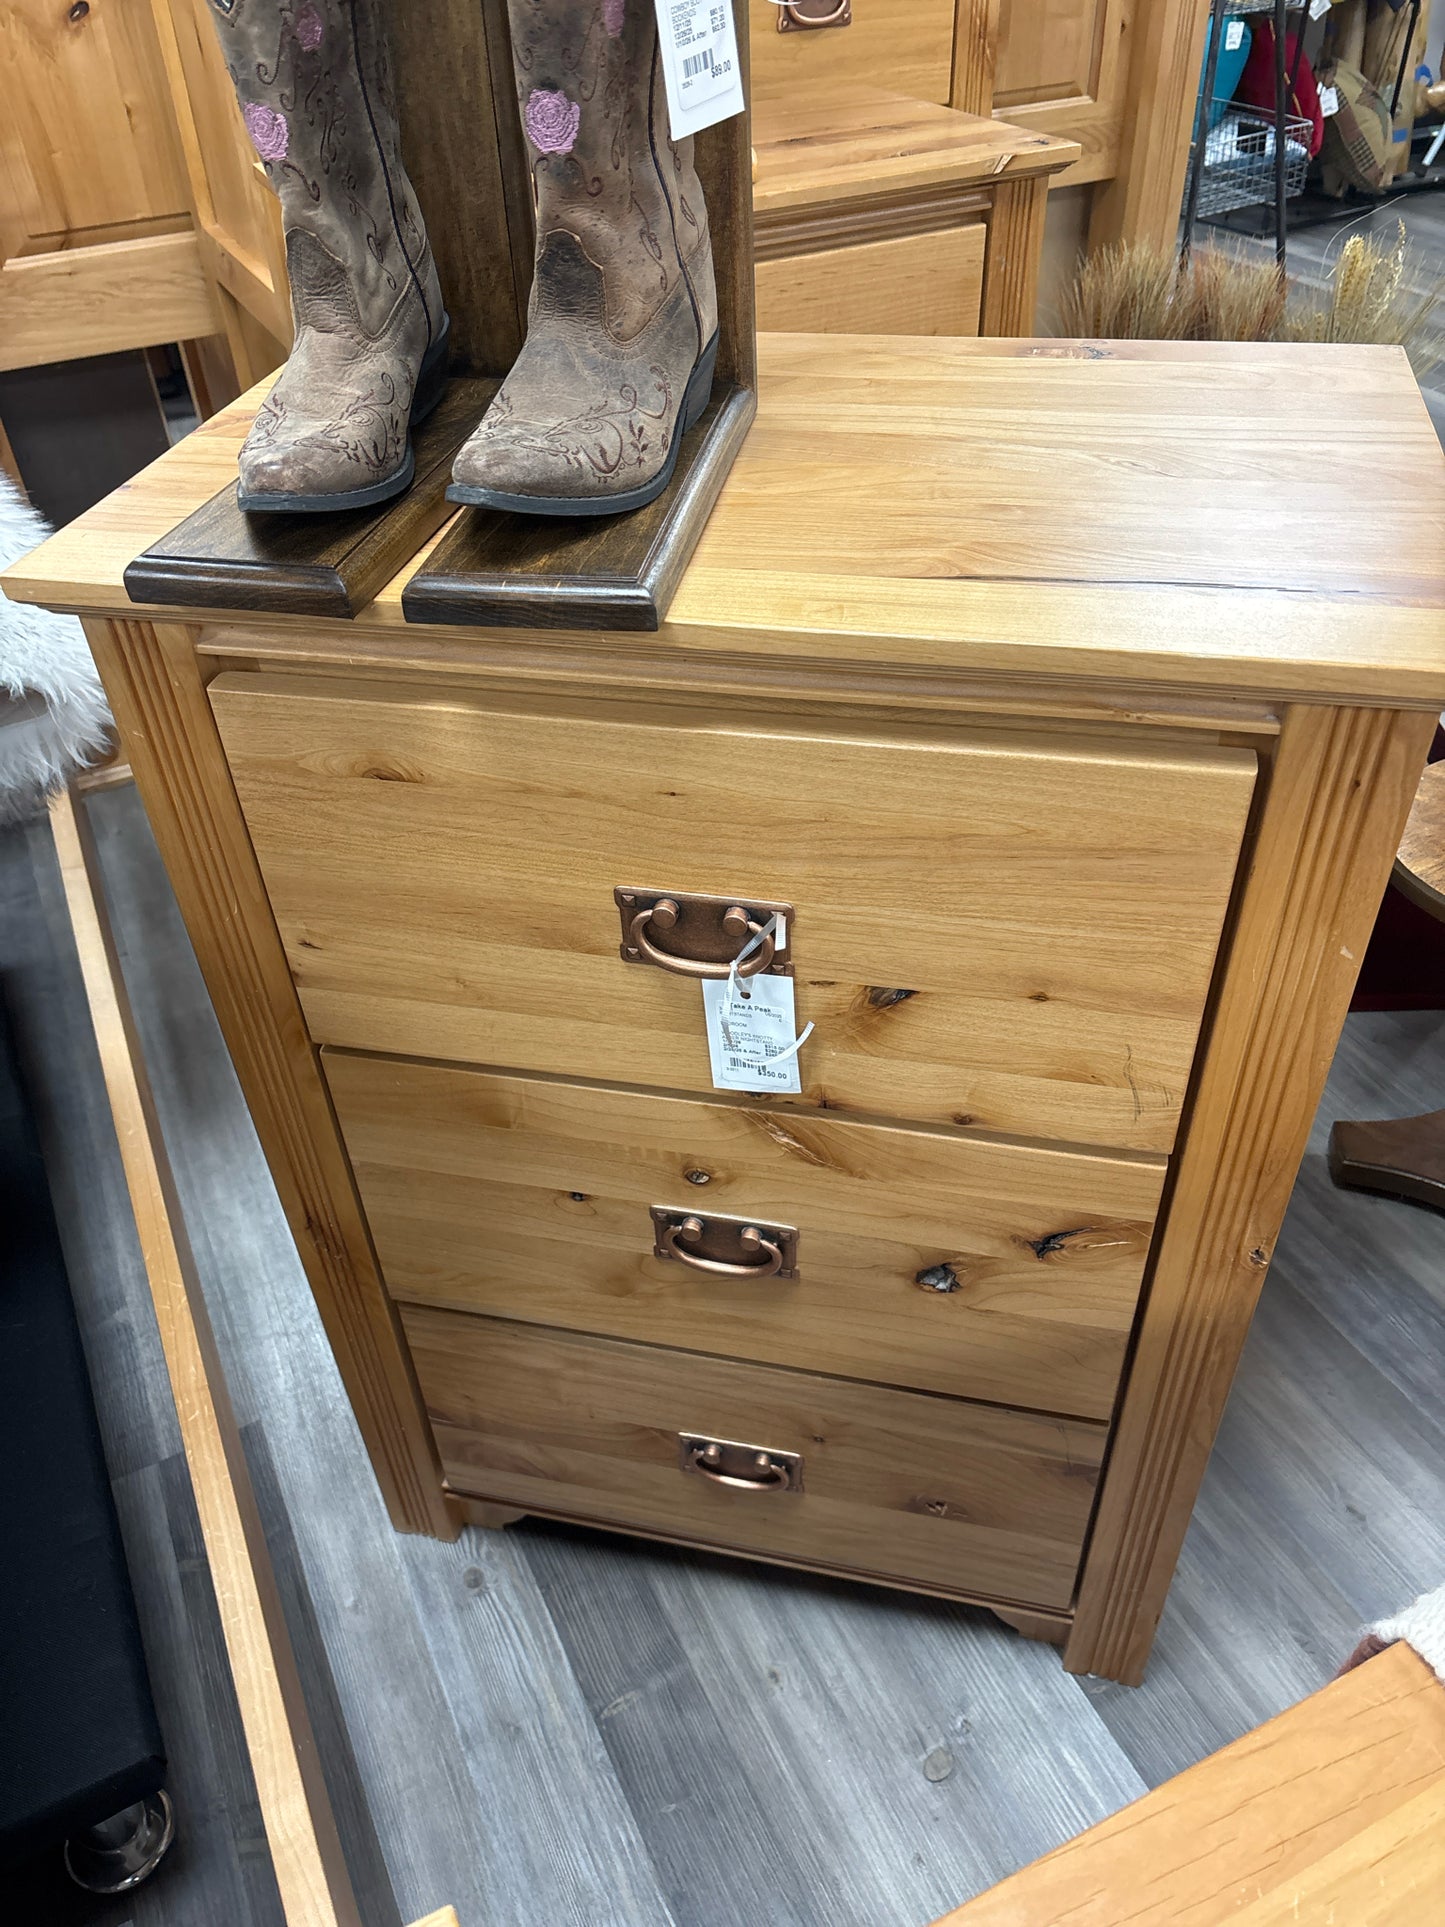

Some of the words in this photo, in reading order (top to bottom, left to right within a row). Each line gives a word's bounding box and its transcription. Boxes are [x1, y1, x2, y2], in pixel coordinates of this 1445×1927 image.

[711, 59, 731, 78] $89.00
[754, 1005, 771, 1013] Peak
[758, 1068, 787, 1079] $350.00
